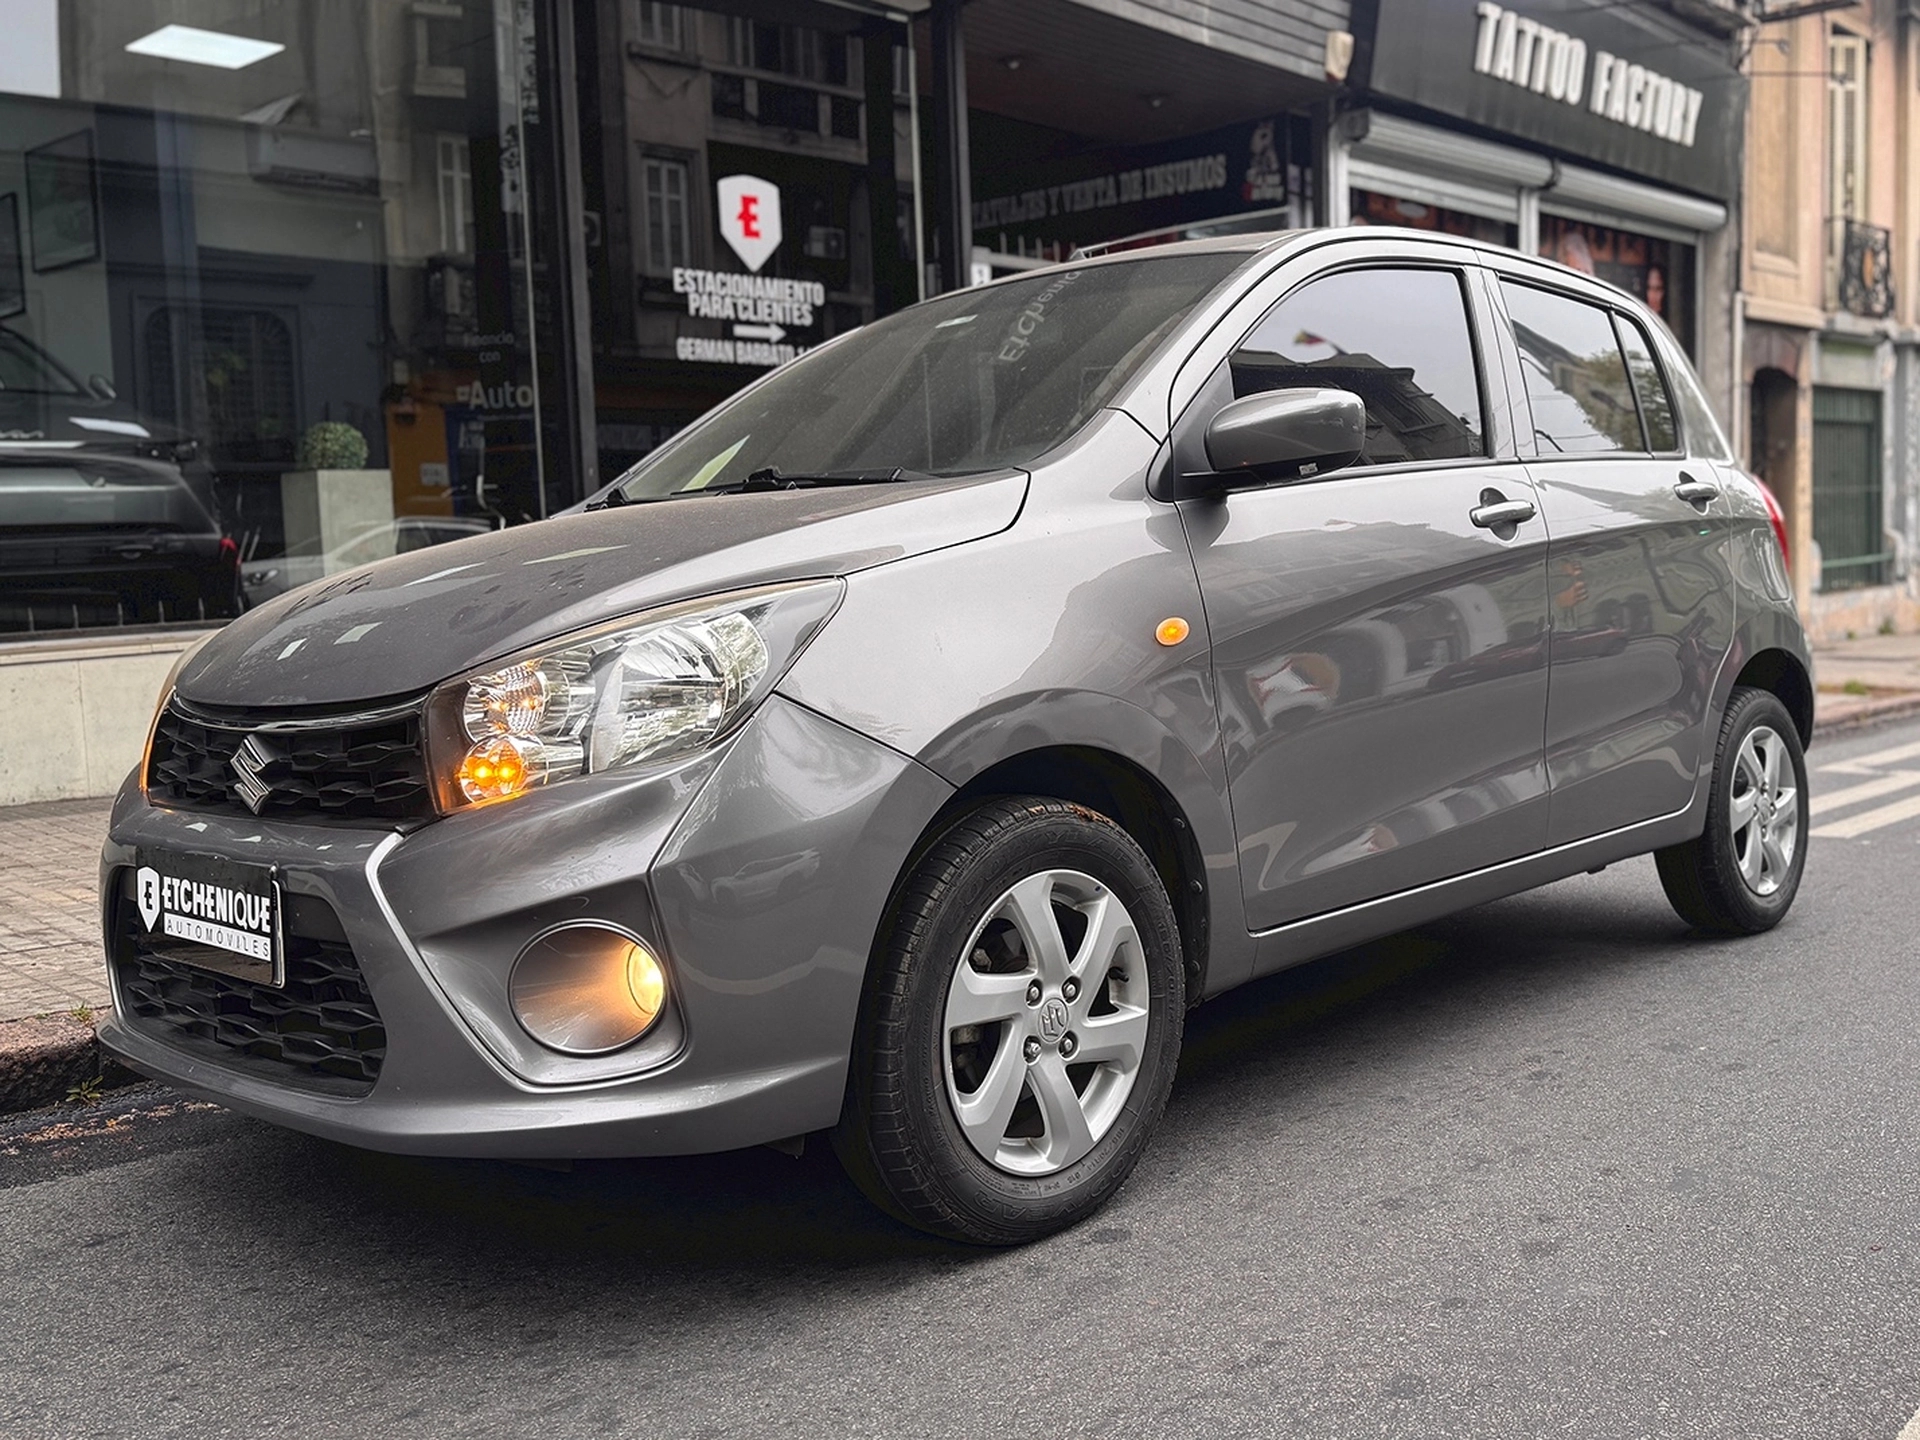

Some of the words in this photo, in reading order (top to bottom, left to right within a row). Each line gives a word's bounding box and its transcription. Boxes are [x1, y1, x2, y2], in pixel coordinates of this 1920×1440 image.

[1474, 1, 1587, 105] TATTOO
[1589, 51, 1703, 147] FACTORY
[1048, 187, 1061, 216] Y
[1063, 174, 1118, 213] VENTA
[1119, 168, 1144, 202] DE
[1144, 155, 1226, 200] INSUMOS
[673, 267, 825, 307] ESTACIONAMIENTO
[688, 293, 736, 320] PARA
[736, 299, 813, 327] CLIENTES
[676, 336, 735, 364] GERMAN
[736, 341, 795, 367] BARBATO
[469, 379, 533, 410] Auto
[162, 875, 271, 933] ETCHENIQUE
[166, 918, 269, 957] AUTOMÓVILES
